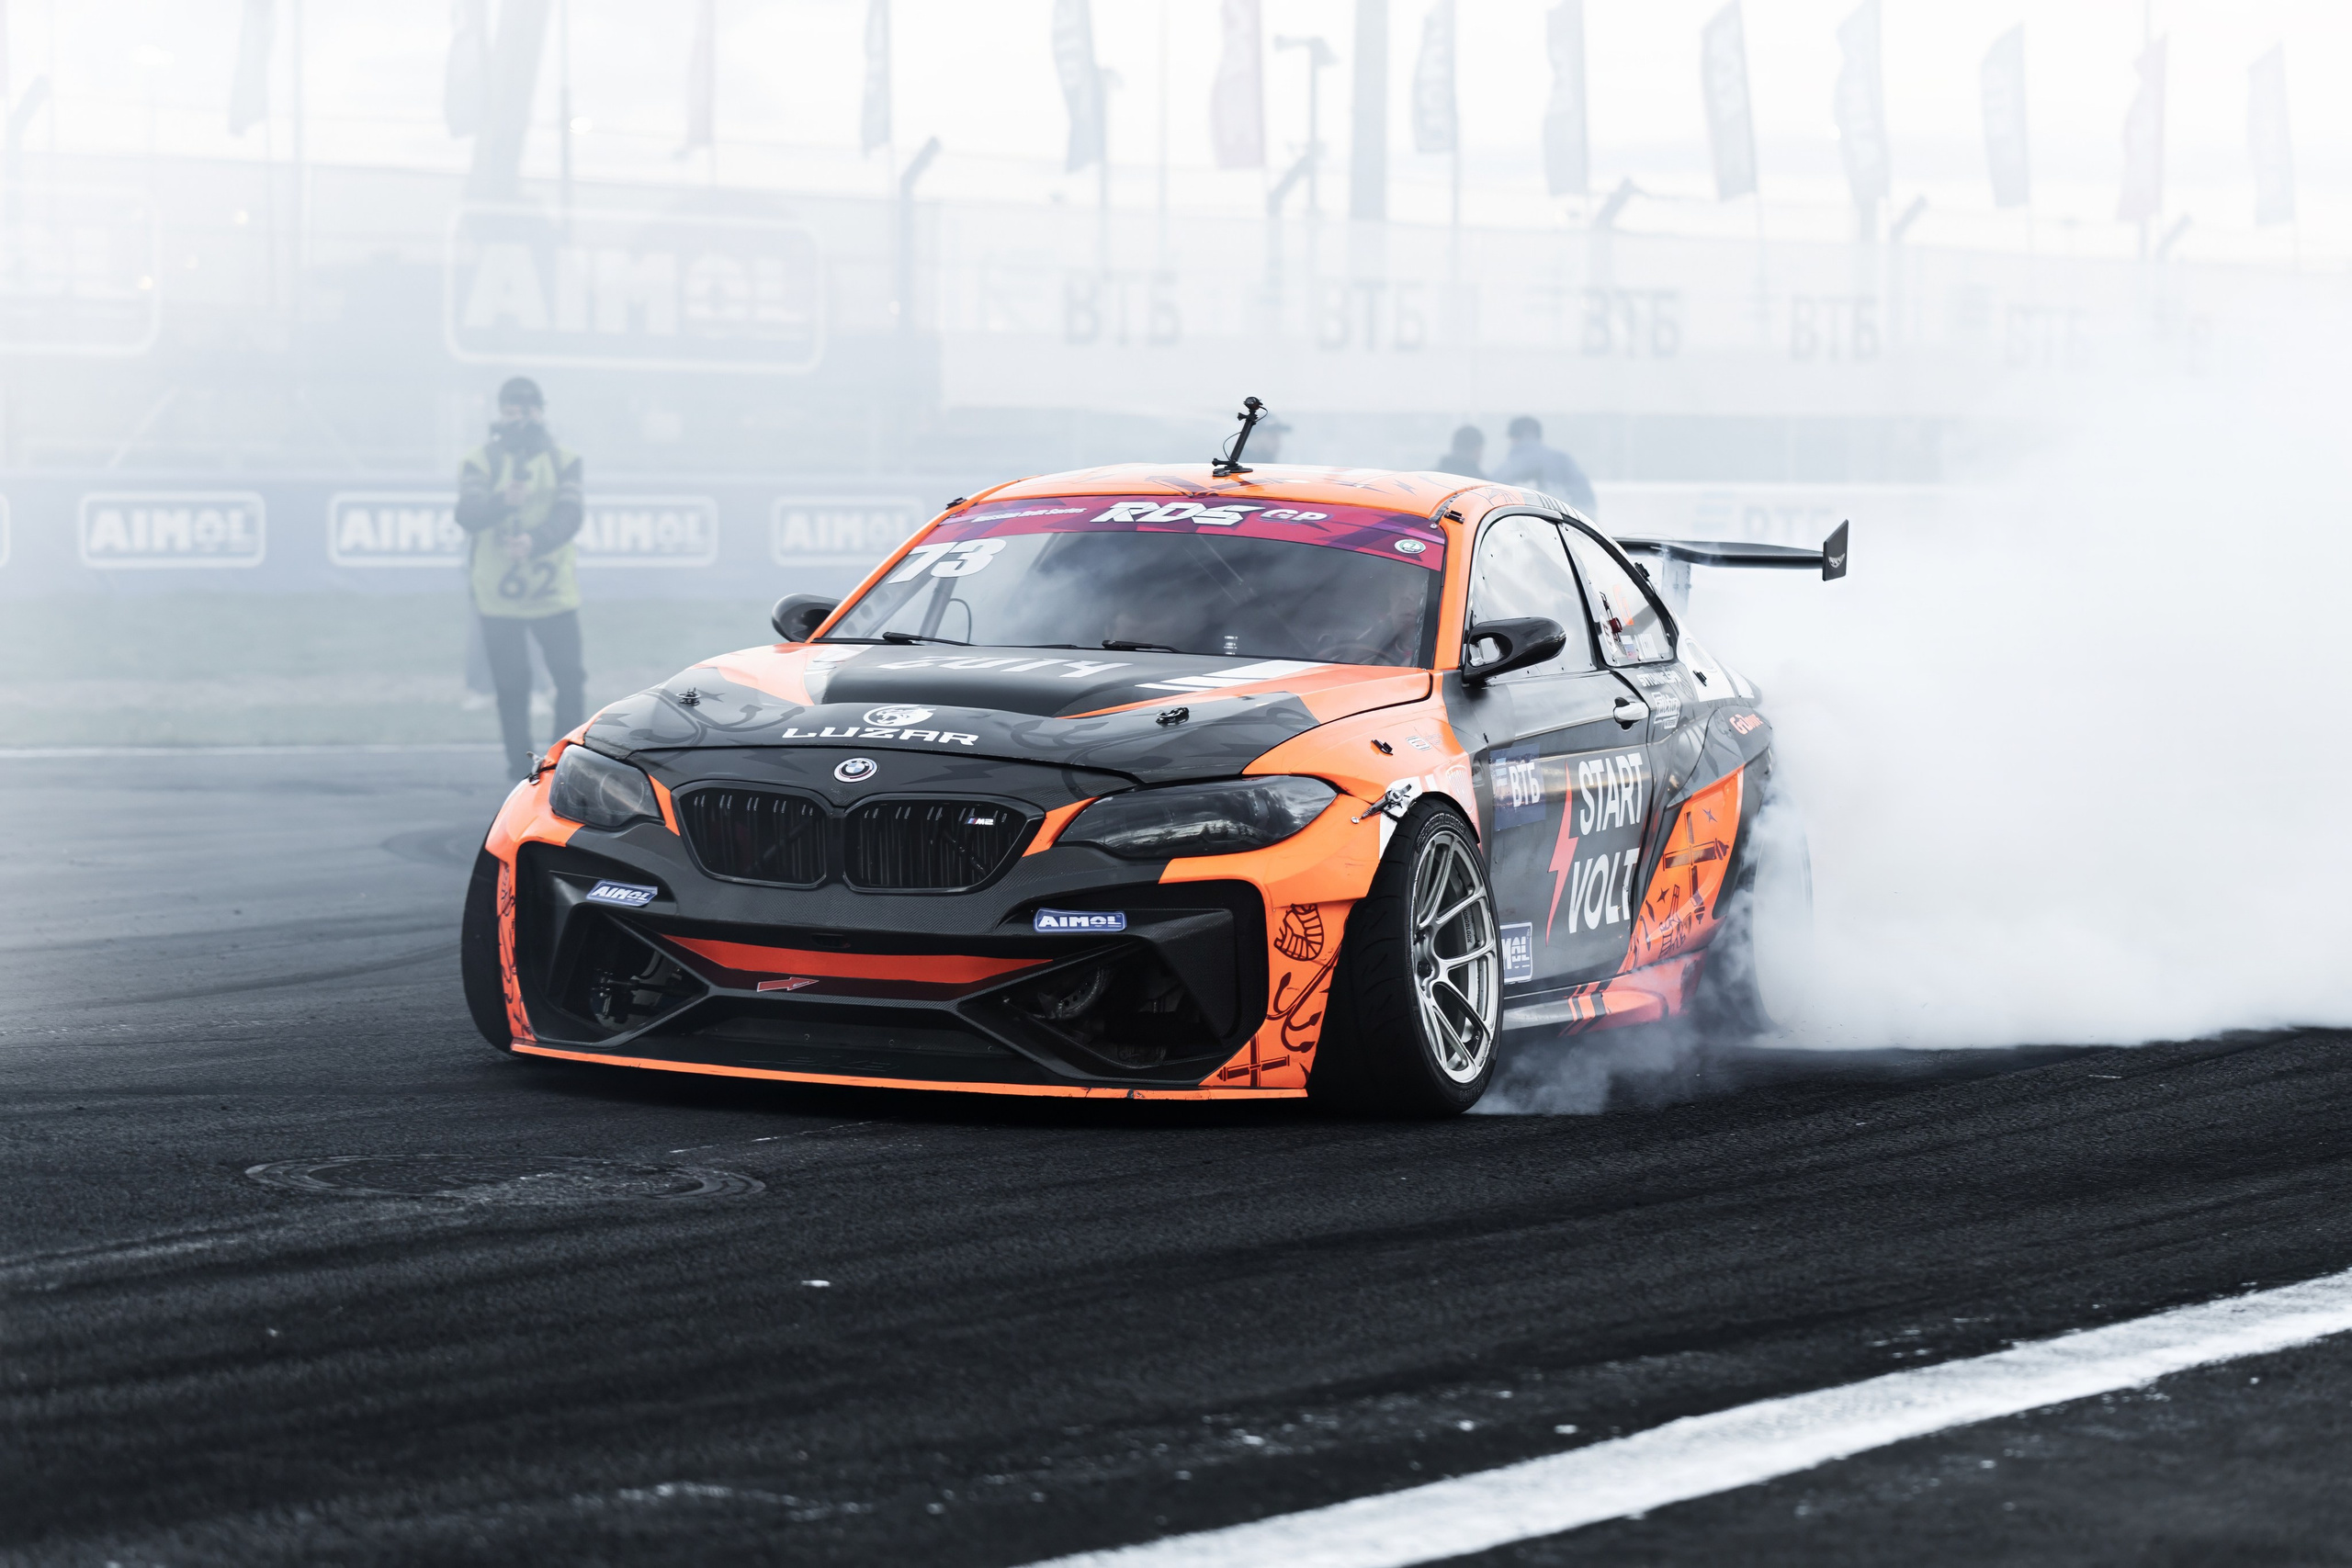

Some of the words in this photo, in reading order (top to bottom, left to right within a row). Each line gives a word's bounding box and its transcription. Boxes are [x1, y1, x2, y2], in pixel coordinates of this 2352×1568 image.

[463, 242, 809, 339] AIMOL
[1790, 295, 1881, 360] ВТБ
[92, 508, 256, 551] AIMOL
[338, 509, 465, 551] AIMO
[1090, 502, 1266, 525] RDS
[1260, 508, 1329, 523] GP
[497, 562, 559, 601] 62
[888, 538, 1007, 584] 73
[781, 727, 979, 746] LUZAR
[1509, 762, 1541, 807] ВТБ
[1578, 752, 1643, 836] START
[591, 886, 650, 902] AIMOL
[1568, 847, 1640, 933] VOLT
[1038, 915, 1122, 928] AIMOL
[1503, 936, 1531, 970] MOL
